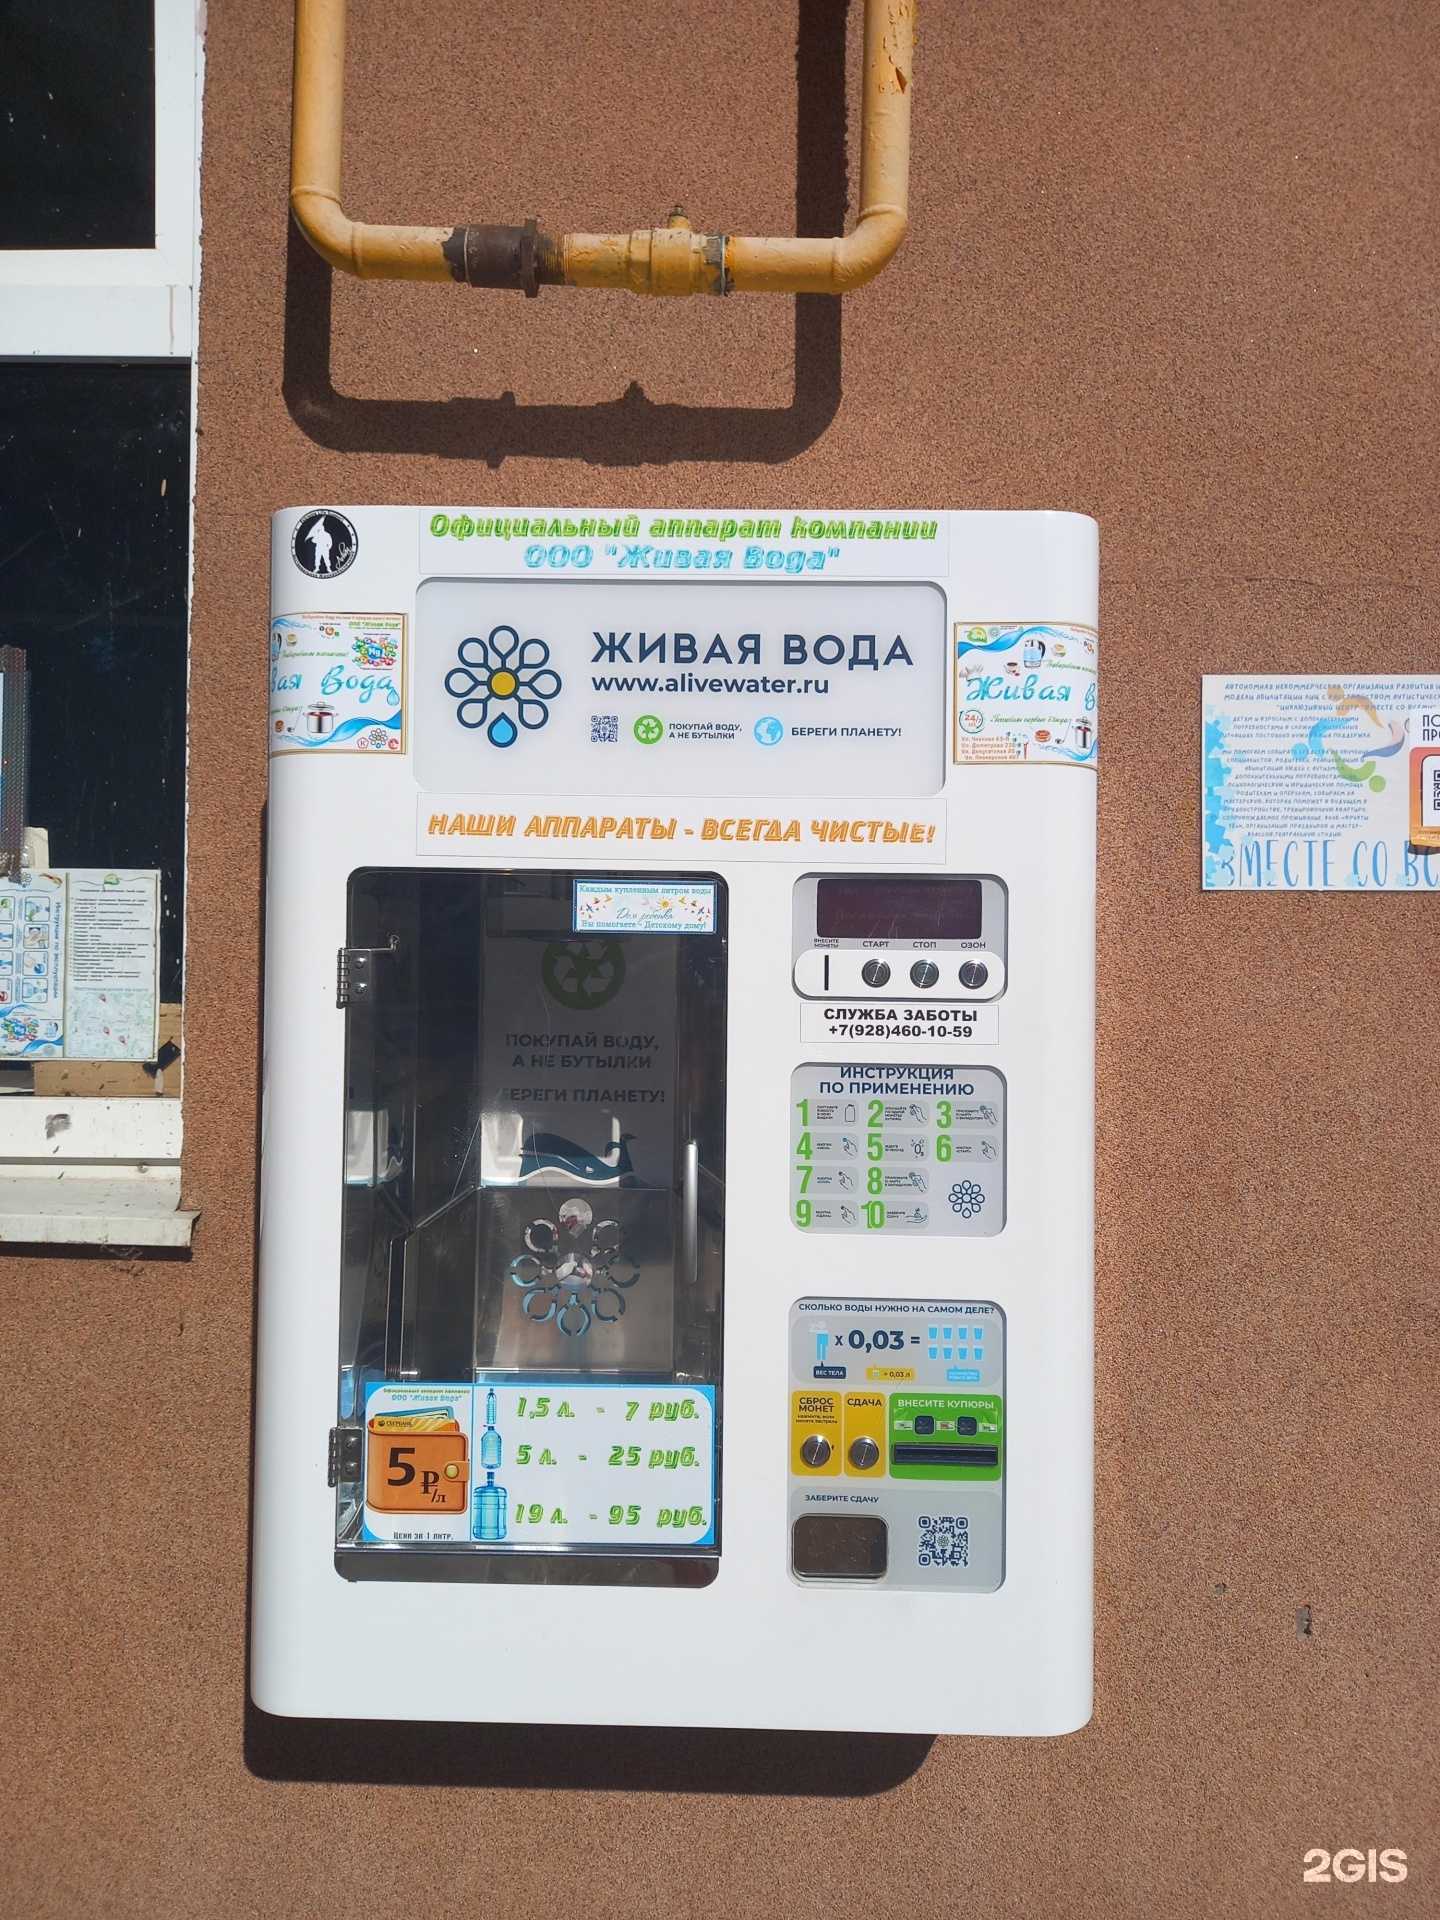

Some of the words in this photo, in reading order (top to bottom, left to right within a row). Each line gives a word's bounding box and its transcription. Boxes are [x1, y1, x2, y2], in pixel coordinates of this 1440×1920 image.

[429, 514, 640, 541] Официальный
[650, 518, 781, 541] аппарат
[791, 516, 937, 540] компании
[524, 545, 593, 568] ООО
[605, 544, 732, 568] "Живая
[591, 632, 761, 664] ЖИВАЯ
[783, 634, 914, 671] ВОДА
[591, 673, 829, 694] www.alivewater.ru
[966, 673, 1071, 702] Живая
[669, 722, 713, 731] ПОКУПАЙ
[716, 723, 742, 733] ВОДУ,
[669, 732, 675, 740] А
[677, 732, 688, 740] НЕ
[690, 732, 735, 740] БУТЫЛКИ
[791, 727, 837, 737] БЕРЕГИ
[840, 727, 902, 738] ПЛАНЕТУ!
[428, 814, 516, 836] НАШИ
[524, 816, 677, 839] АППАРАТЫ
[700, 818, 801, 841] ВСЕГДА
[811, 820, 936, 843] ЧИСТЫЕ!
[1353, 840, 1388, 887] СО
[824, 1008, 898, 1021] СЛУЖБА
[903, 1009, 977, 1022] ЗАБОТЫ
[505, 1032, 597, 1049] ПОКУПАЙ
[603, 1035, 660, 1051] ВОДУ,
[829, 1024, 973, 1039] +7(928)460-10-59
[512, 1055, 525, 1067] А
[531, 1055, 554, 1067] НЕ
[561, 1055, 651, 1069] БУТЫЛКИ
[840, 1066, 954, 1081] ИНСТРУКЦИЯ
[573, 1088, 665, 1102] ПЛАНЕТУ!
[819, 1081, 844, 1094] ПО
[849, 1082, 974, 1095] ПРИМЕНЕНИЮ
[796, 1099, 808, 1126] 1
[868, 1100, 883, 1128] 2
[936, 1101, 952, 1128] 3
[796, 1132, 813, 1160] 4
[868, 1133, 883, 1161] 5
[936, 1134, 952, 1162] 6
[796, 1165, 813, 1193] 7
[867, 1167, 882, 1194] 8
[796, 1199, 811, 1227] 9
[861, 1200, 884, 1228] 10
[799, 1303, 842, 1311] СКОЛЬКО
[844, 1304, 873, 1313] ВОДЫ
[875, 1305, 910, 1313] НУЖНО
[912, 1305, 925, 1313] НА
[927, 1306, 963, 1314] САМОМ
[965, 1306, 994, 1315] ДЕЛЕ?
[848, 1329, 904, 1353] 0,03
[516, 1397, 550, 1419] 1,5
[557, 1401, 575, 1417] л.
[625, 1401, 639, 1421] 7
[649, 1399, 699, 1421] руб.
[799, 1397, 834, 1405] СБРОС
[847, 1398, 882, 1407] СДАЧА
[897, 1400, 945, 1408] ВНЕСИТЕ
[947, 1400, 994, 1408] КУПЮРЫ
[388, 1447, 415, 1486] 5
[516, 1444, 531, 1464] 5
[539, 1449, 557, 1465] л.
[608, 1445, 641, 1466] 25
[648, 1447, 699, 1469] руб.
[805, 1494, 848, 1502] ЗАБЕРИТЕ
[850, 1495, 879, 1504] СДАЧУ
[515, 1504, 543, 1523] 19
[551, 1508, 568, 1524] л.
[608, 1505, 641, 1525] 95
[657, 1506, 707, 1528] руб.
